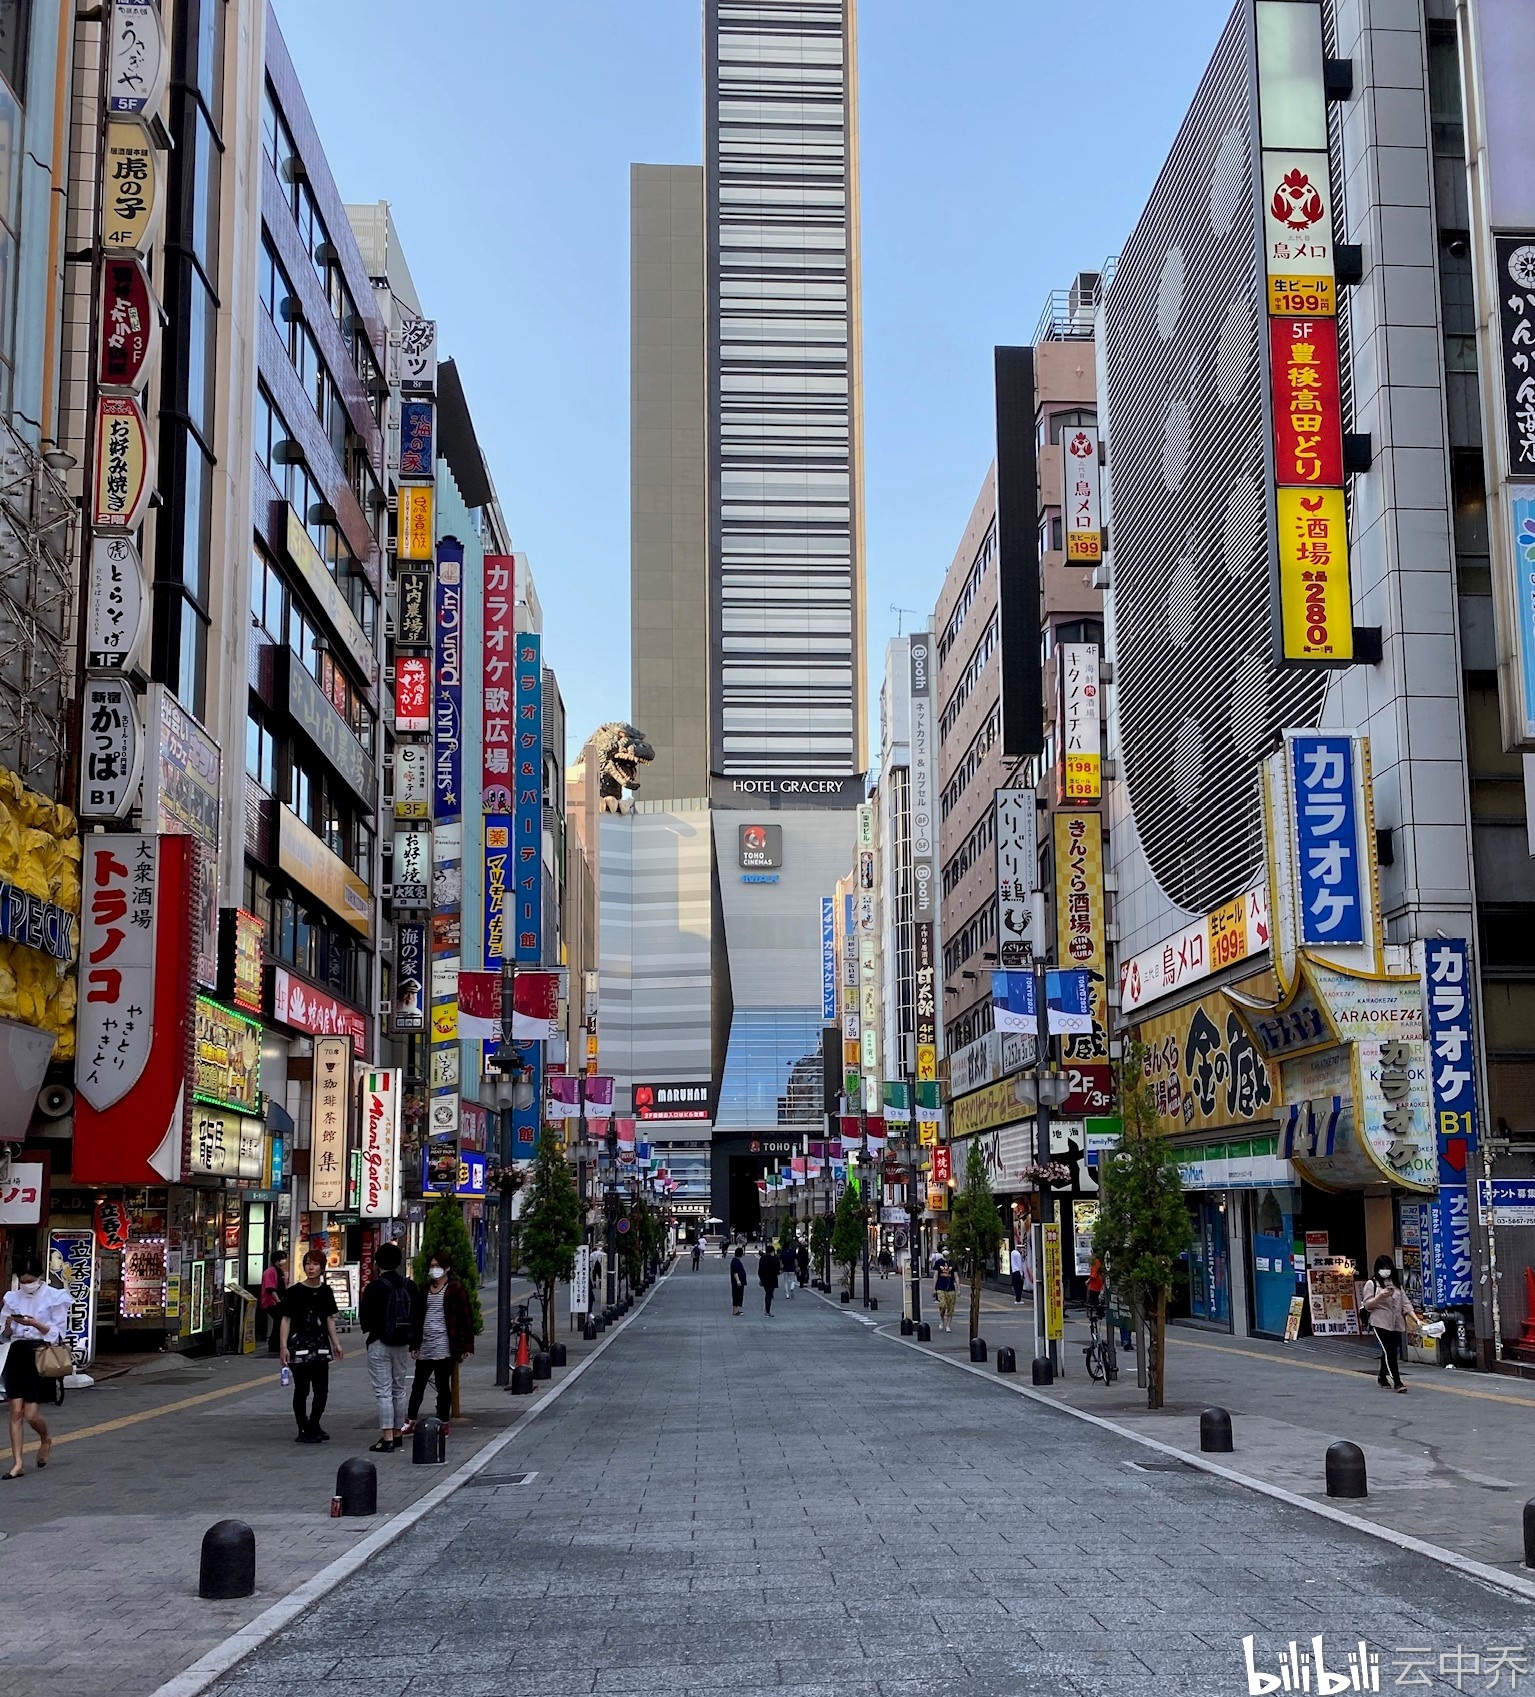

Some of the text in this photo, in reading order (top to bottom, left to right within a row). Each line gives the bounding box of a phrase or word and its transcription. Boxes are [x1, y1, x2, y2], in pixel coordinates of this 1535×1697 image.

[116, 20, 151, 92] うさぎや
[117, 99, 138, 110] 5F
[111, 157, 148, 219] 虎の子
[108, 231, 132, 243] 4F
[1273, 242, 1327, 262] 鳥メロ
[1274, 280, 1328, 293] 生ビール
[107, 297, 132, 349] カラオケ
[1292, 323, 1313, 338] 5F
[132, 336, 143, 363] 3F
[407, 325, 431, 376] ダーツ
[1286, 342, 1323, 481] 豊後高田どり
[107, 419, 129, 512] お好み焼き
[1076, 480, 1092, 529] 鳥メロ
[1070, 534, 1098, 542] 生ビール
[1074, 544, 1099, 554] 199
[1295, 517, 1332, 566] 酒場
[1301, 571, 1328, 582] 全品
[403, 575, 424, 633] 山内農場
[1305, 583, 1328, 645] 280
[408, 632, 420, 641] 5F
[1085, 647, 1097, 656] 4F
[96, 653, 120, 667] 1F
[486, 565, 510, 775] カラオケ歌広場
[911, 644, 928, 690] Booth
[91, 691, 121, 704] 新宿
[399, 673, 414, 715] さかい
[412, 670, 427, 706] 焼肉屋
[1068, 653, 1082, 749] キタノイチバ
[404, 719, 421, 730] 4F
[90, 705, 122, 782] かっぱ
[437, 702, 453, 790] SHINJUKU
[90, 790, 115, 804] B1
[520, 648, 537, 948] カラオケ&パーティー館
[733, 781, 843, 793] HOTEL GRACERY
[403, 803, 421, 816] 3F
[743, 852, 765, 860] TOHO
[1303, 745, 1354, 934] カラオケ
[402, 833, 421, 884] お好み焼
[131, 841, 156, 930] 大衆酒場
[395, 886, 427, 898] 大阪家
[741, 875, 780, 884] IMAX
[914, 864, 931, 911] Booth
[1068, 820, 1091, 935] きんくら酒場
[87, 850, 129, 1004] トラノコ
[1211, 901, 1242, 938] 生ビール
[401, 928, 420, 975] 海の家
[1071, 951, 1093, 961] KURA
[1073, 936, 1088, 945] KIN
[823, 940, 835, 1015] カラオケランド
[1162, 933, 1204, 987] 鳥メロ
[917, 965, 935, 1018] 甘太郎
[1026, 977, 1035, 1014] TOKYO 2020
[1079, 976, 1087, 1000] TOKYO
[113, 1004, 143, 1071] やきとり
[919, 1024, 934, 1032] 4F
[919, 1034, 934, 1043] 3F
[1431, 947, 1470, 1103] カラオケ
[86, 1018, 119, 1084] やきとん
[657, 1088, 708, 1103] MARUHAN
[1069, 1070, 1094, 1093] 2F
[1379, 1038, 1418, 1170] カラオケ
[1440, 1111, 1472, 1134] B1
[317, 1080, 339, 1173] 珈琲茶館集
[1274, 1096, 1341, 1160] 747
[763, 1143, 789, 1151] TOHO
[937, 1158, 948, 1179] 焼肉
[0, 1187, 37, 1204] ノコ
[321, 1191, 334, 1200] 2F
